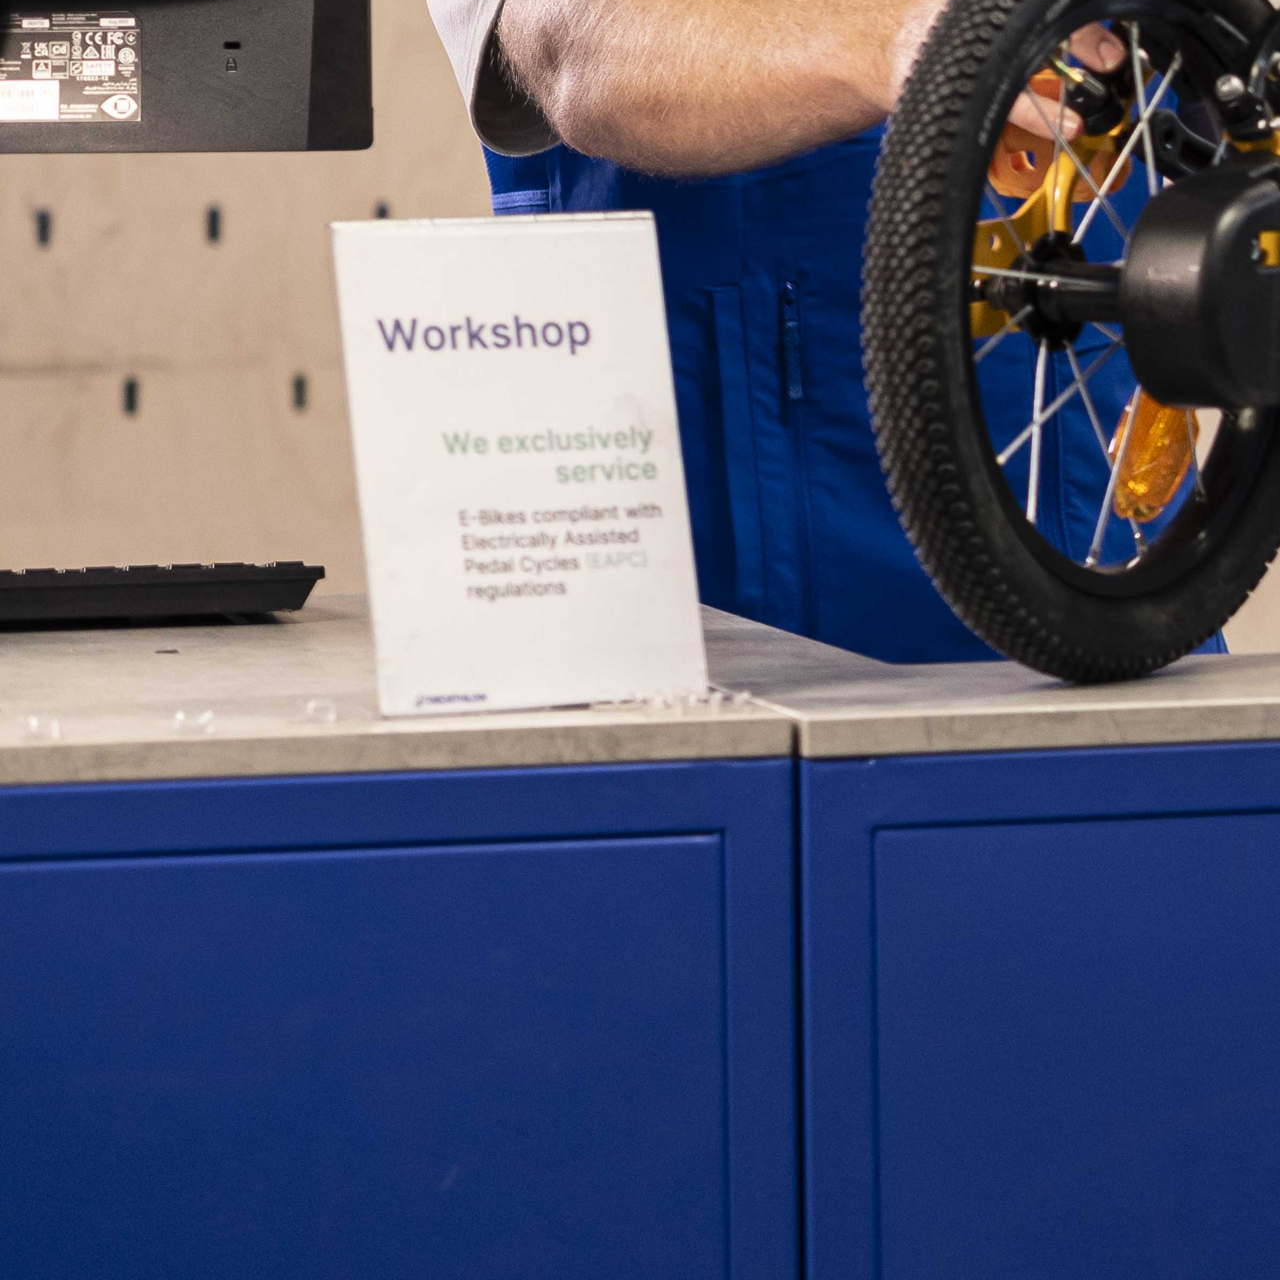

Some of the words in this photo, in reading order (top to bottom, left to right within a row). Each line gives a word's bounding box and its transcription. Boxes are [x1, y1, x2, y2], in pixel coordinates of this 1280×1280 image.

[377, 315, 591, 356] Workshop
[442, 431, 489, 455] We
[497, 425, 654, 455] exclusively
[555, 458, 658, 484] service
[458, 508, 527, 527] E-Bikes
[531, 505, 618, 525] compliant
[624, 502, 663, 519] with
[461, 532, 557, 551] Electrically
[564, 528, 639, 546] Assisted
[464, 558, 514, 573] Pedal
[519, 555, 580, 575] Cycles
[467, 581, 567, 602] regulations
